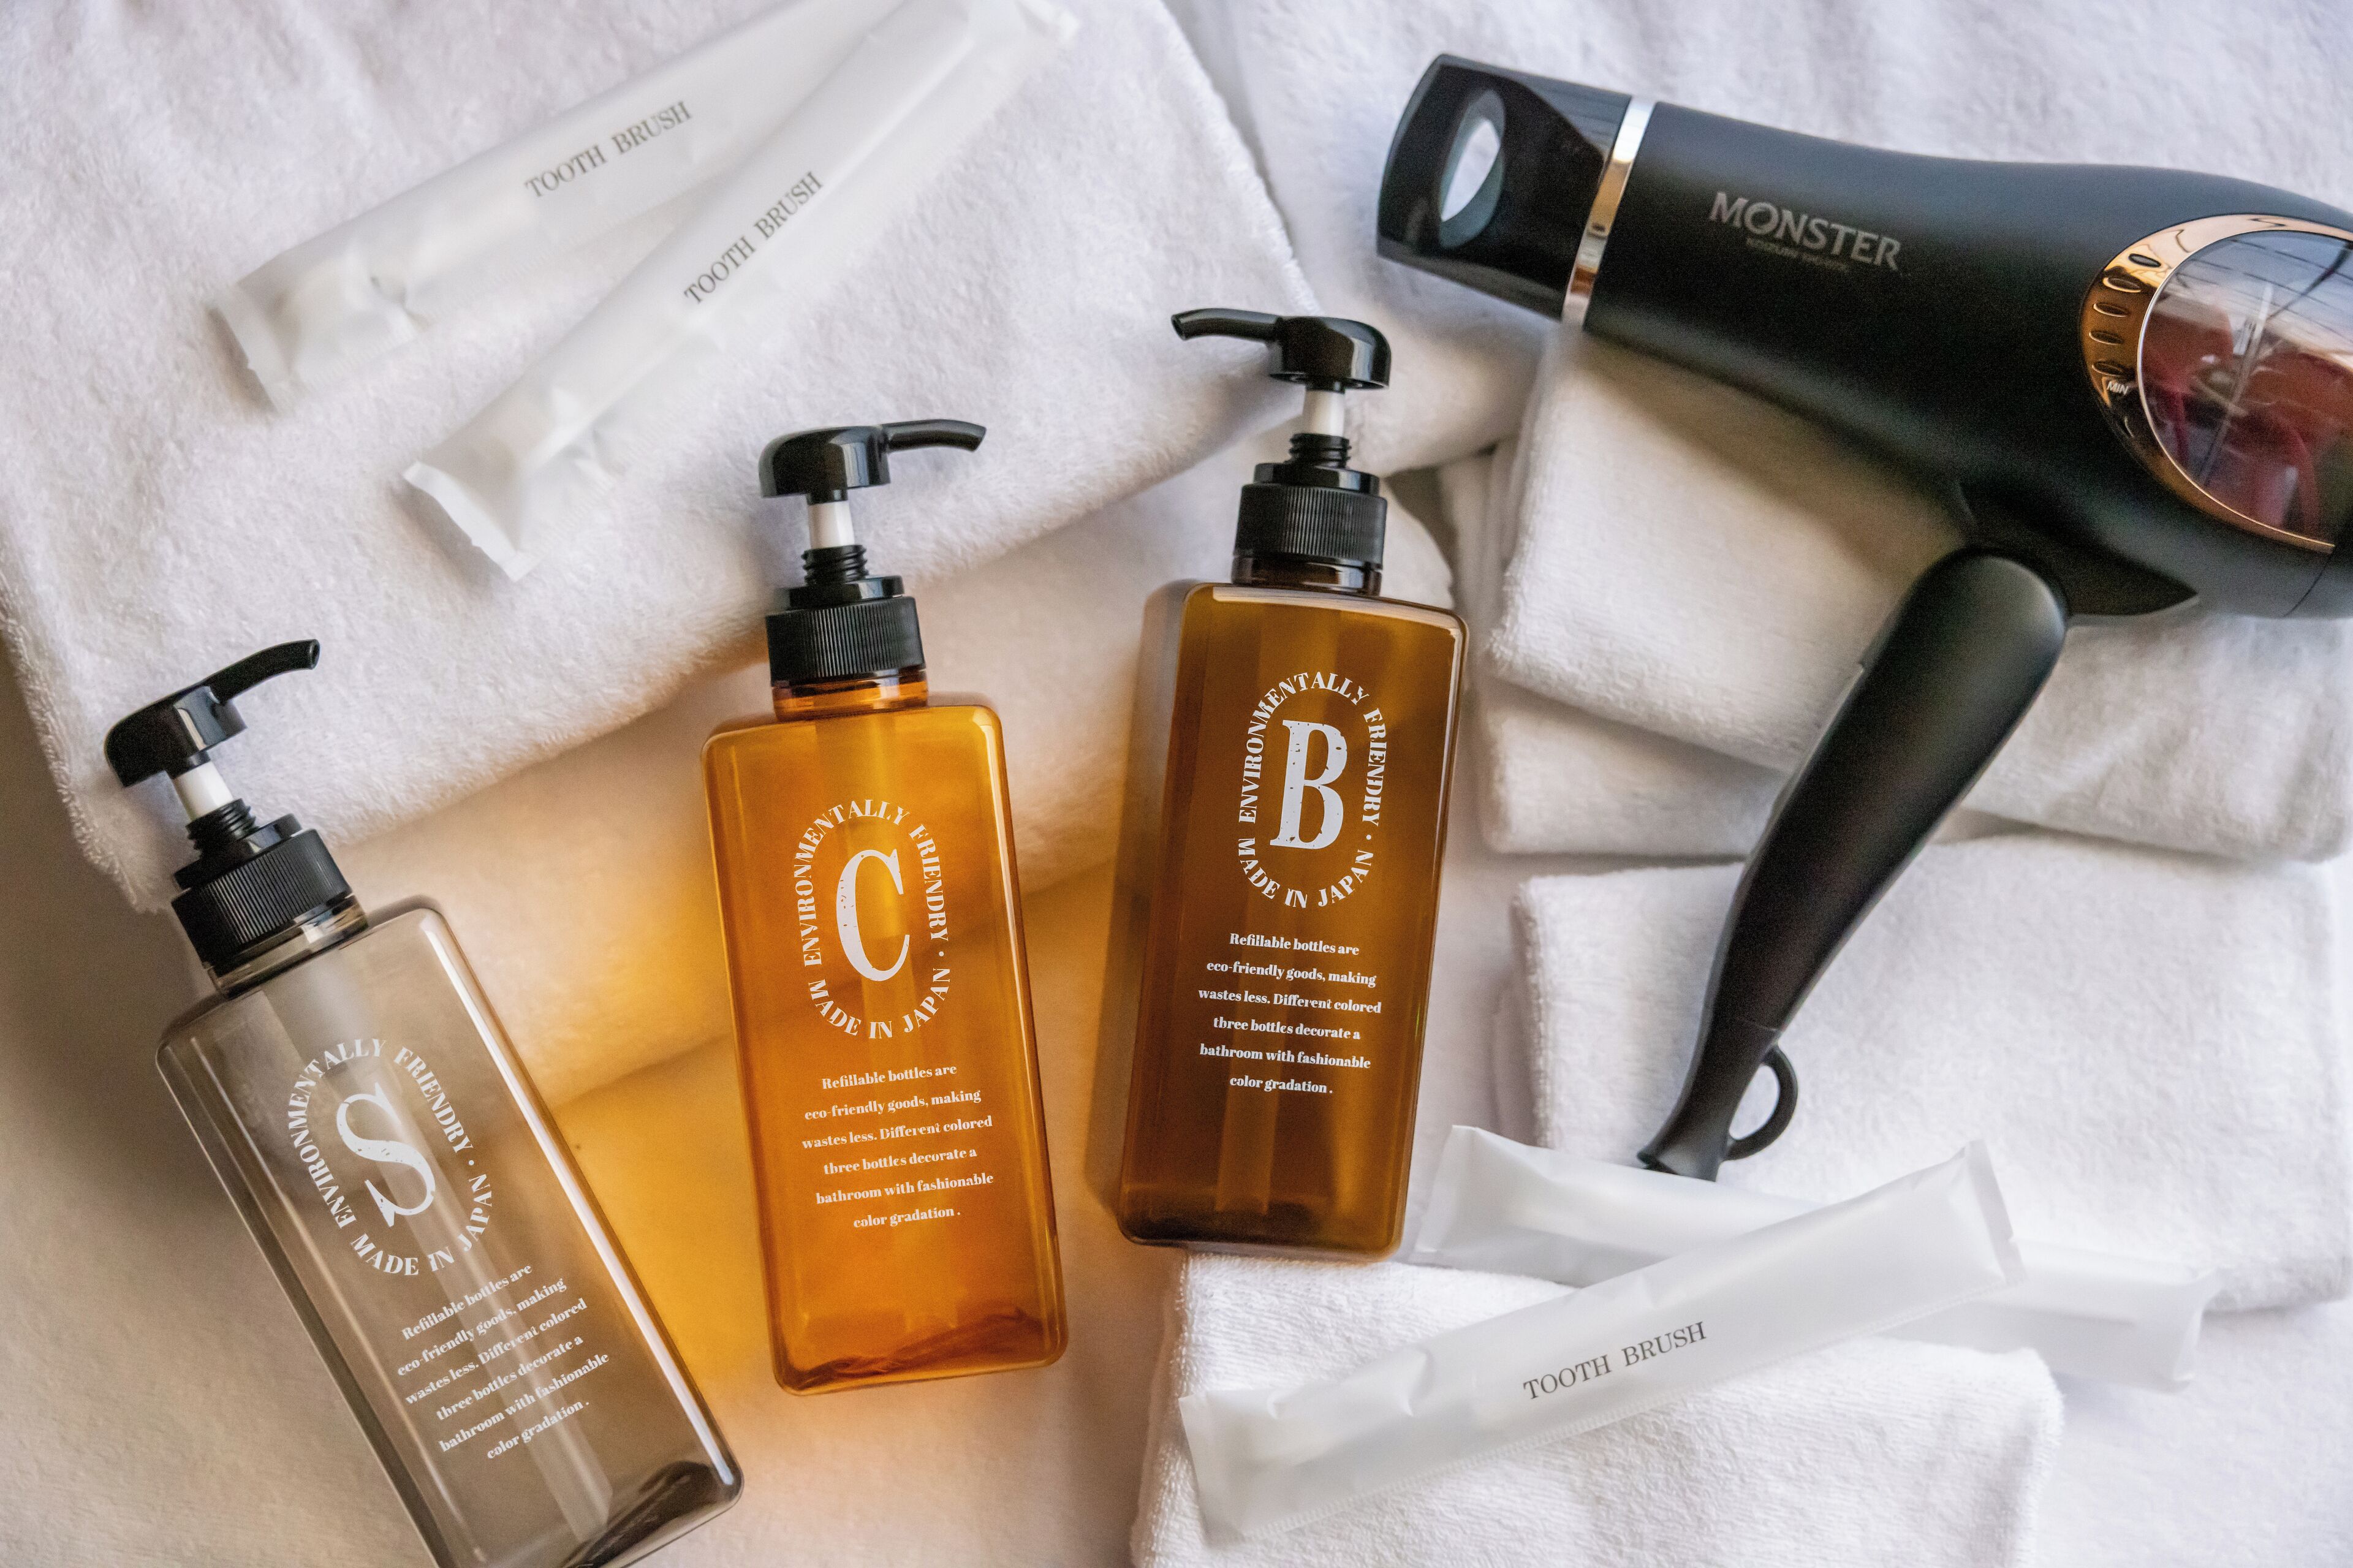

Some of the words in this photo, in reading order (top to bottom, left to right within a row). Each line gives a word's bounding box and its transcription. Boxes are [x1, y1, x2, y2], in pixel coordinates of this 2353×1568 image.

[524, 145, 608, 198] TOOTH
[611, 100, 693, 155] BRUSH
[683, 236, 757, 305] TOOTH
[753, 170, 824, 240] BRUSH
[1709, 192, 1900, 270] MONSTER
[2107, 381, 2129, 395] MIN
[1238, 672, 1370, 824] ENVIRONMENTALLY
[1362, 708, 1387, 827] FRIENDRY
[1270, 719, 1347, 849] B
[794, 799, 911, 967] ENVIRONMENTALLY
[909, 824, 949, 942] FRIENDRY
[1238, 838, 1280, 900] MADE
[1284, 888, 1308, 908] IN
[1318, 849, 1374, 907] JAPAN
[836, 849, 910, 982] C
[1230, 933, 1290, 949] Refillable
[1293, 938, 1335, 953] bottles
[1338, 945, 1360, 955] are
[808, 979, 862, 1036] MADE
[868, 1020, 893, 1039] IN
[901, 967, 951, 1033] JAPAN
[1199, 990, 1241, 1001] wastes
[1244, 991, 1270, 1004] less.
[1273, 994, 1332, 1009] Different
[1333, 999, 1382, 1013] colored
[1207, 961, 1284, 979] eco-friendly
[1328, 971, 1377, 988] making
[1200, 1043, 1263, 1060] bathroom
[1266, 1050, 1295, 1062] with
[1297, 1051, 1371, 1069] fashionable
[1213, 1017, 1248, 1030] three
[1250, 1019, 1293, 1034] bottles
[1295, 1023, 1351, 1039] decorate
[1353, 1031, 1360, 1040] a
[805, 1101, 885, 1120] eco-friendly
[931, 1090, 982, 1105] making
[822, 1071, 886, 1089] Refillable
[888, 1067, 932, 1081] bottles
[934, 1066, 957, 1076] are
[1230, 1075, 1263, 1088] color
[288, 1039, 387, 1229] ENVIRONMENTALLY
[393, 1047, 474, 1153] FRIENDRY
[336, 1082, 436, 1227] S
[801, 1135, 847, 1149] wastes
[849, 1132, 877, 1144] less.
[879, 1123, 940, 1140] Different
[943, 1115, 993, 1132] colored
[824, 1162, 860, 1175] three
[862, 1155, 906, 1170] bottles
[909, 1149, 967, 1164] decorate
[969, 1148, 977, 1157] a
[350, 1233, 419, 1276] MADE
[427, 1246, 455, 1272] IN
[457, 1173, 492, 1252] JAPAN
[816, 1189, 882, 1204] bathroom
[884, 1181, 915, 1196] with
[917, 1173, 994, 1192] fashionable
[854, 1215, 887, 1228] color
[397, 1328, 475, 1376] eco-friendly
[516, 1278, 567, 1311] making
[401, 1301, 466, 1340] Refillable
[464, 1278, 510, 1306] bottles
[509, 1265, 532, 1282] are
[405, 1374, 451, 1405] wastes
[450, 1362, 479, 1381] less.
[477, 1327, 539, 1365] Different
[539, 1298, 588, 1331] colored
[436, 1395, 473, 1420] three
[472, 1371, 517, 1401] bottles
[517, 1341, 574, 1377] decorate
[574, 1336, 583, 1346] a
[1523, 1354, 1612, 1399] TOOTH
[1621, 1321, 1707, 1367] BRUSH
[438, 1412, 506, 1452] bathroom
[505, 1393, 536, 1416] with
[535, 1353, 610, 1399] fashionable
[487, 1434, 520, 1459] color
